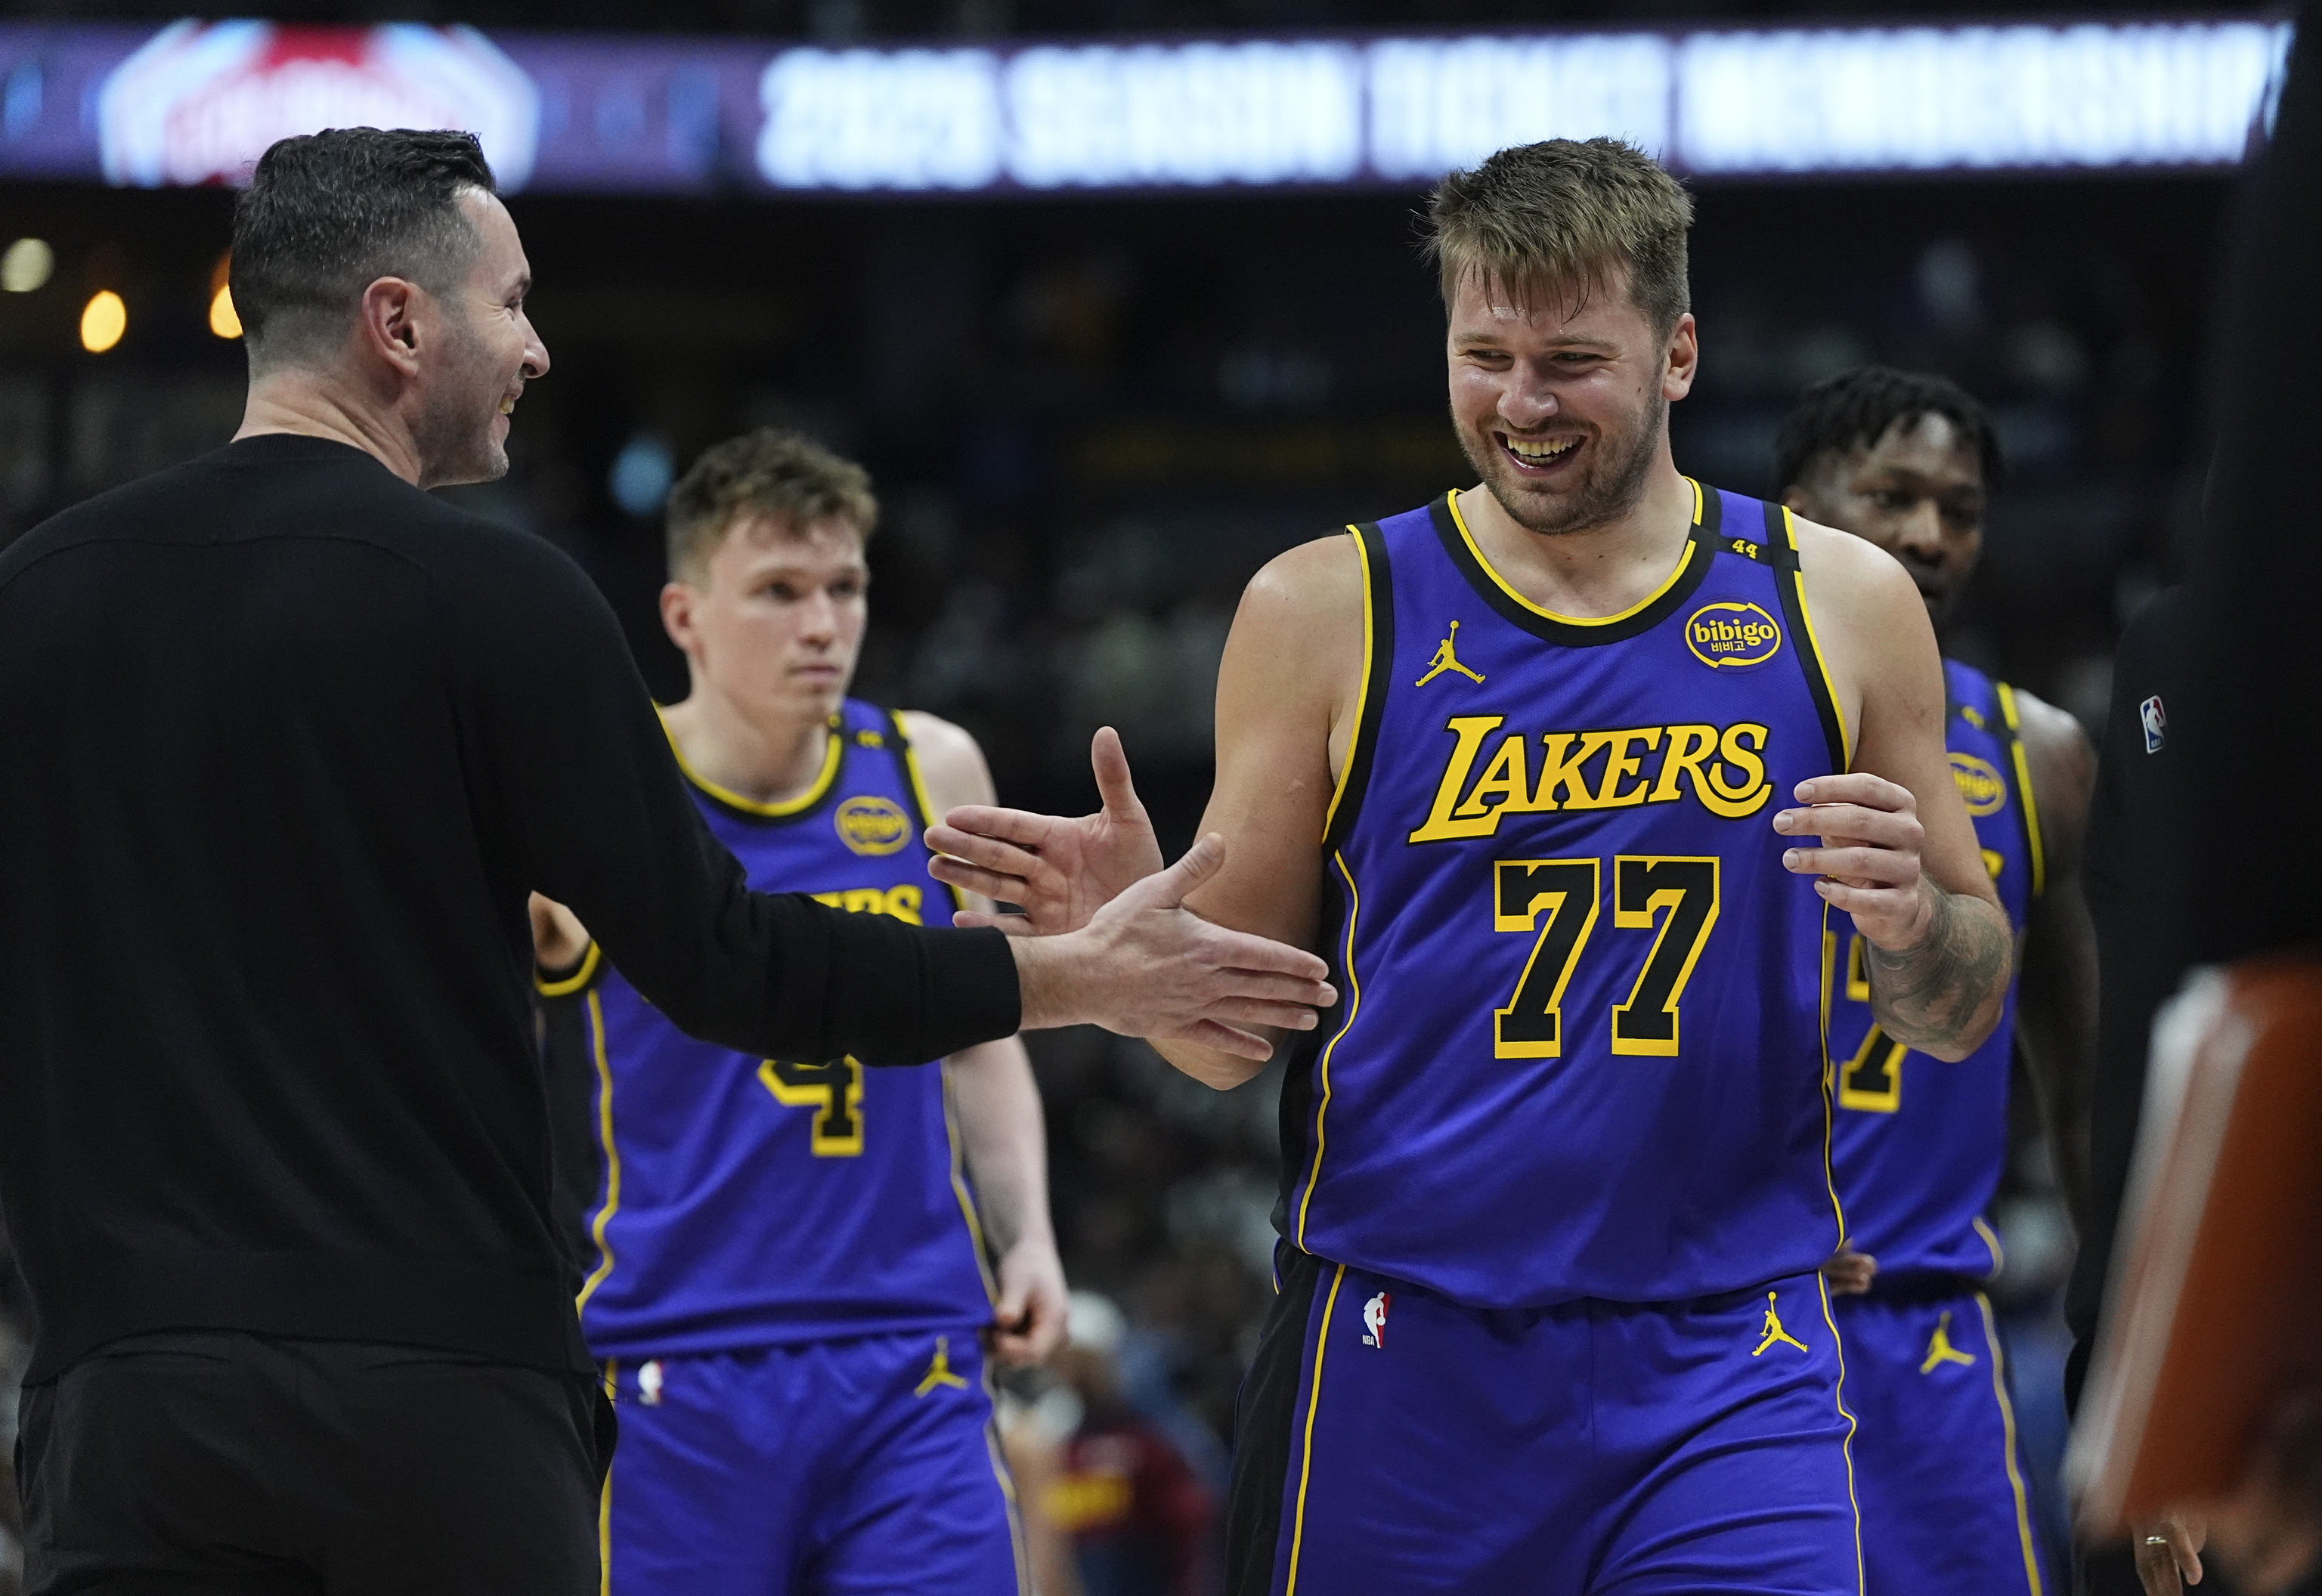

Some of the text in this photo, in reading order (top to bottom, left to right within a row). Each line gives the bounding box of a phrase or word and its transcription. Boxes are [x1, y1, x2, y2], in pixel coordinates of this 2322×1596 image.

[1004, 44, 1361, 187] SEASON
[1370, 36, 1667, 180] TICKET
[1732, 540, 1757, 558] 44
[1693, 619, 1774, 646] bibigo
[1711, 641, 1746, 652] 비비고
[1407, 714, 1773, 845] LAKERS
[1494, 855, 1720, 1059] 77
[1362, 1335, 1374, 1345] NBA
